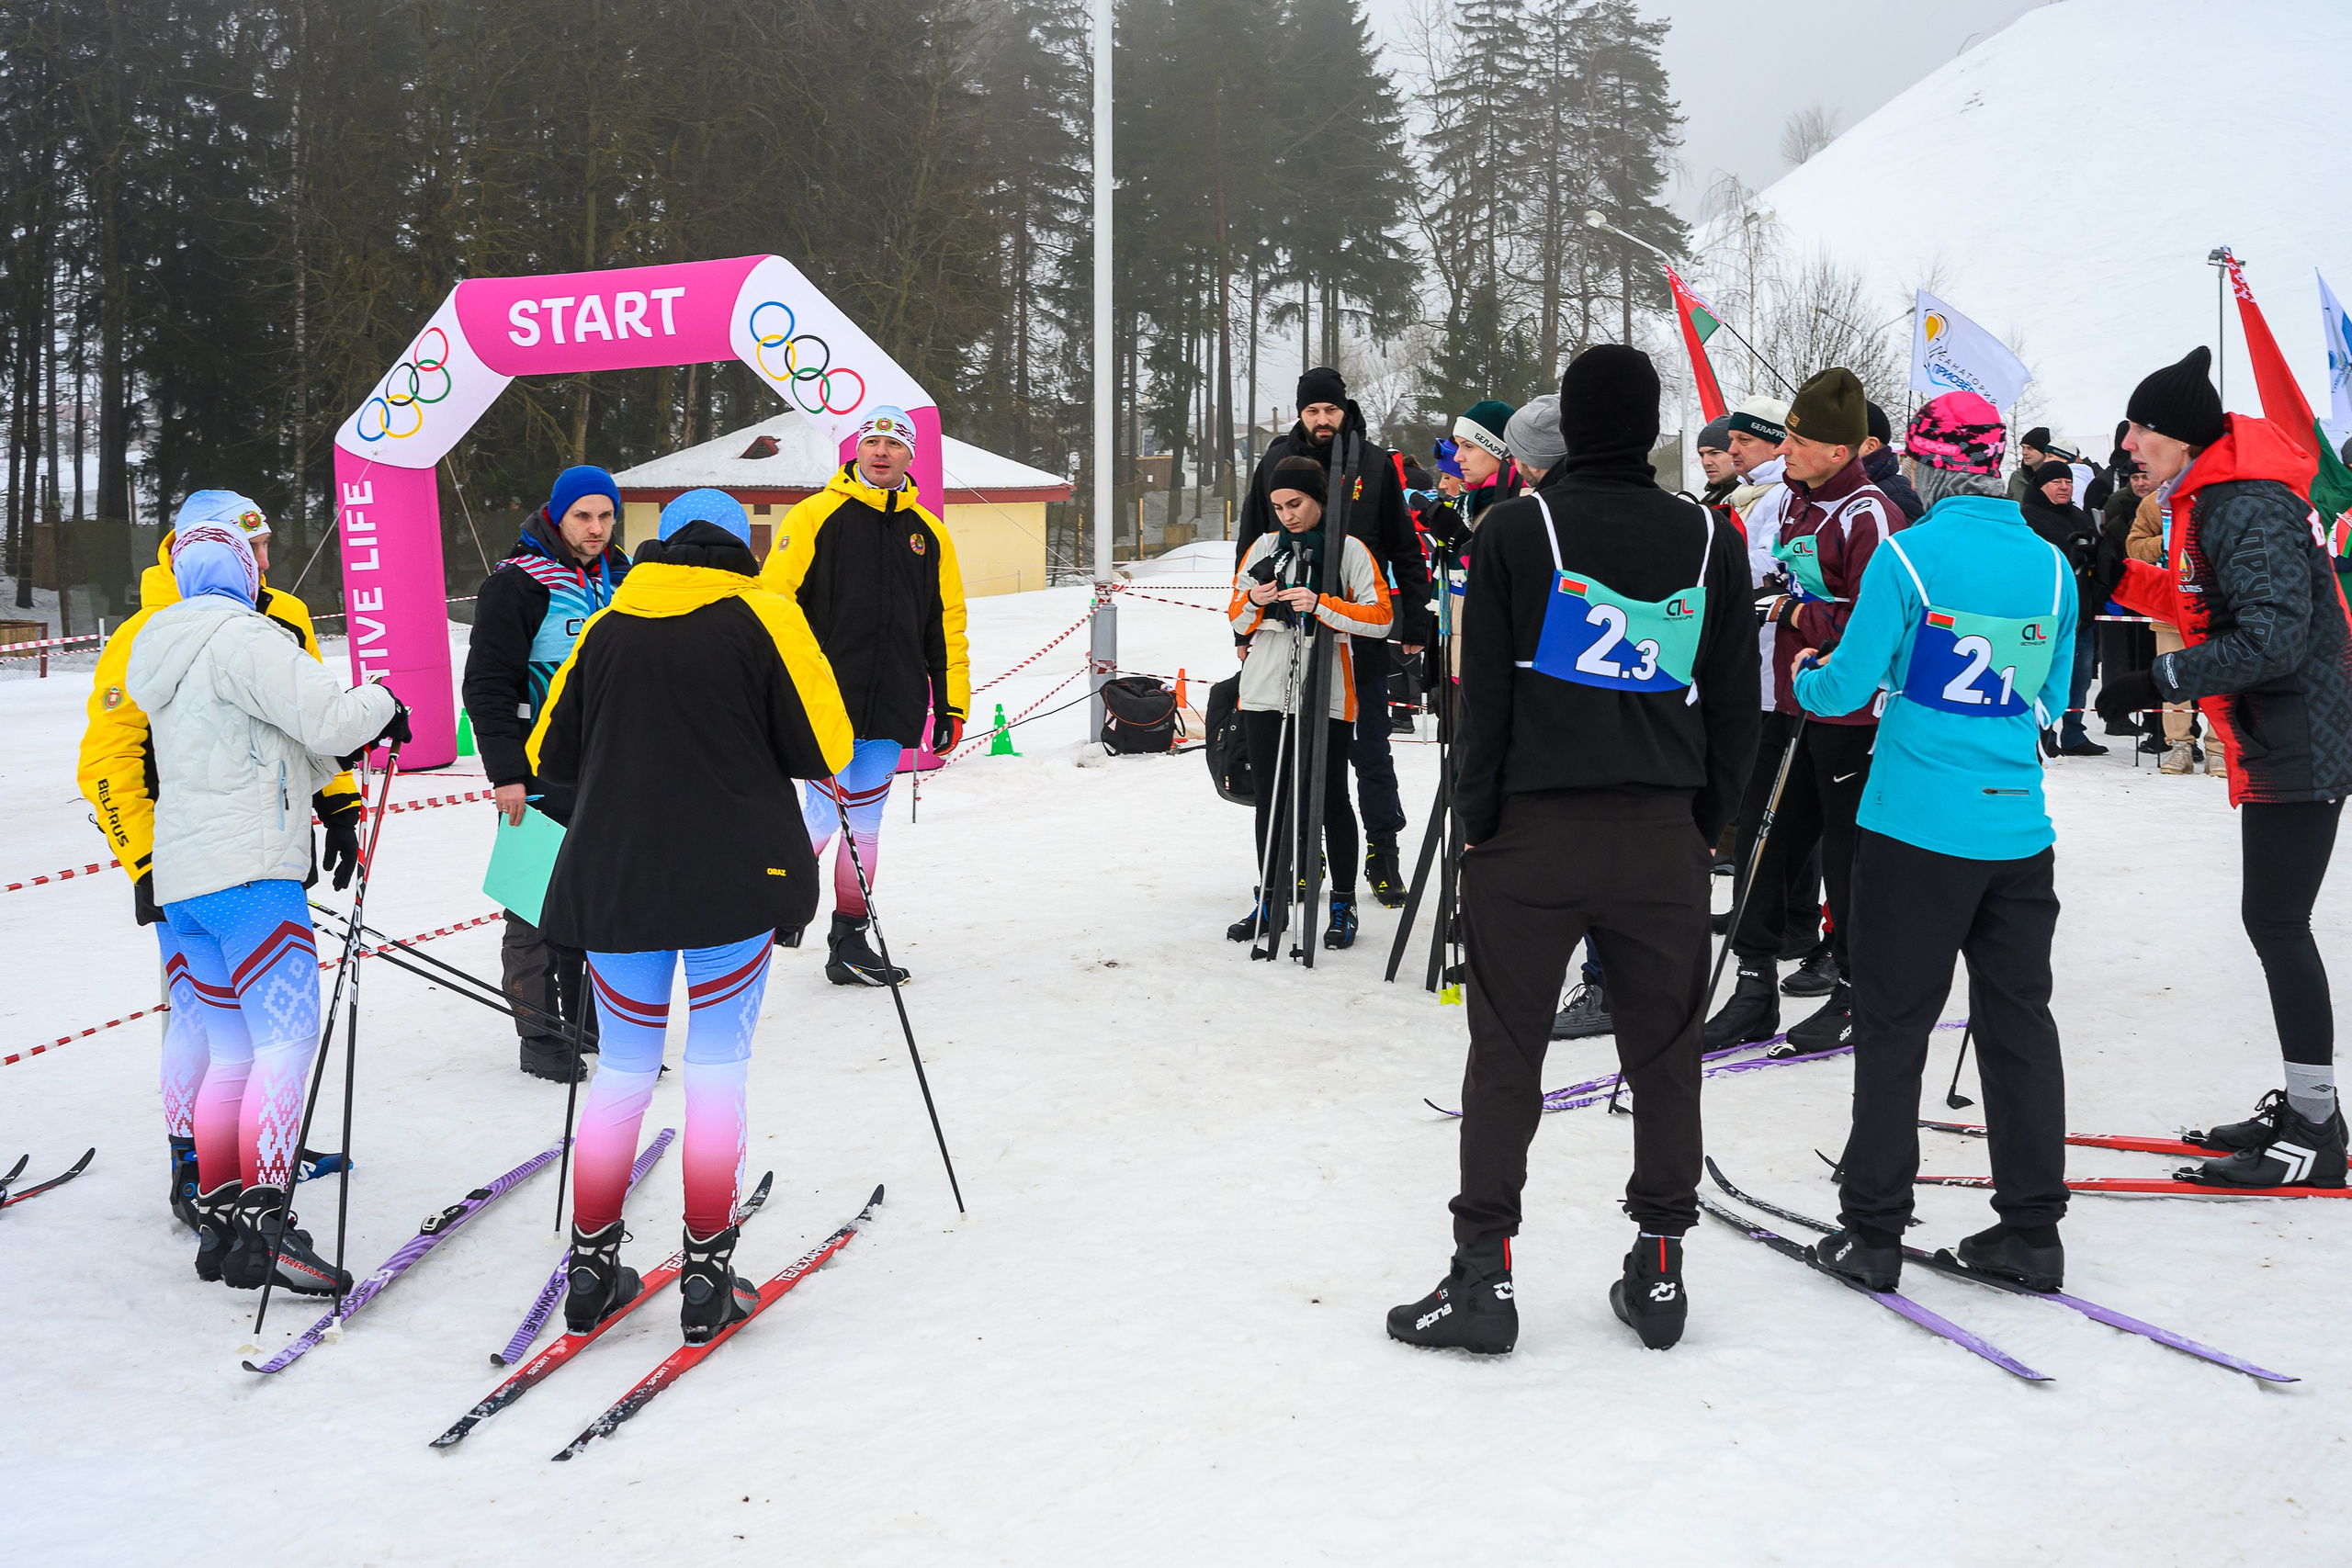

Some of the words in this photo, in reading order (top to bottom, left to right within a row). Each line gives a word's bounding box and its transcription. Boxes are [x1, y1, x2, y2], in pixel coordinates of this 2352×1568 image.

[508, 287, 686, 347] START
[1474, 433, 1504, 456] БЕЛАРУ
[343, 480, 380, 571] LIFE
[353, 586, 391, 685] TIVE
[1575, 603, 1660, 681] 2.3
[1941, 634, 2017, 705] 2.1
[1415, 1302, 1453, 1331] alpina
[526, 1355, 551, 1376] SPORT
[646, 1365, 670, 1386] SPORT
